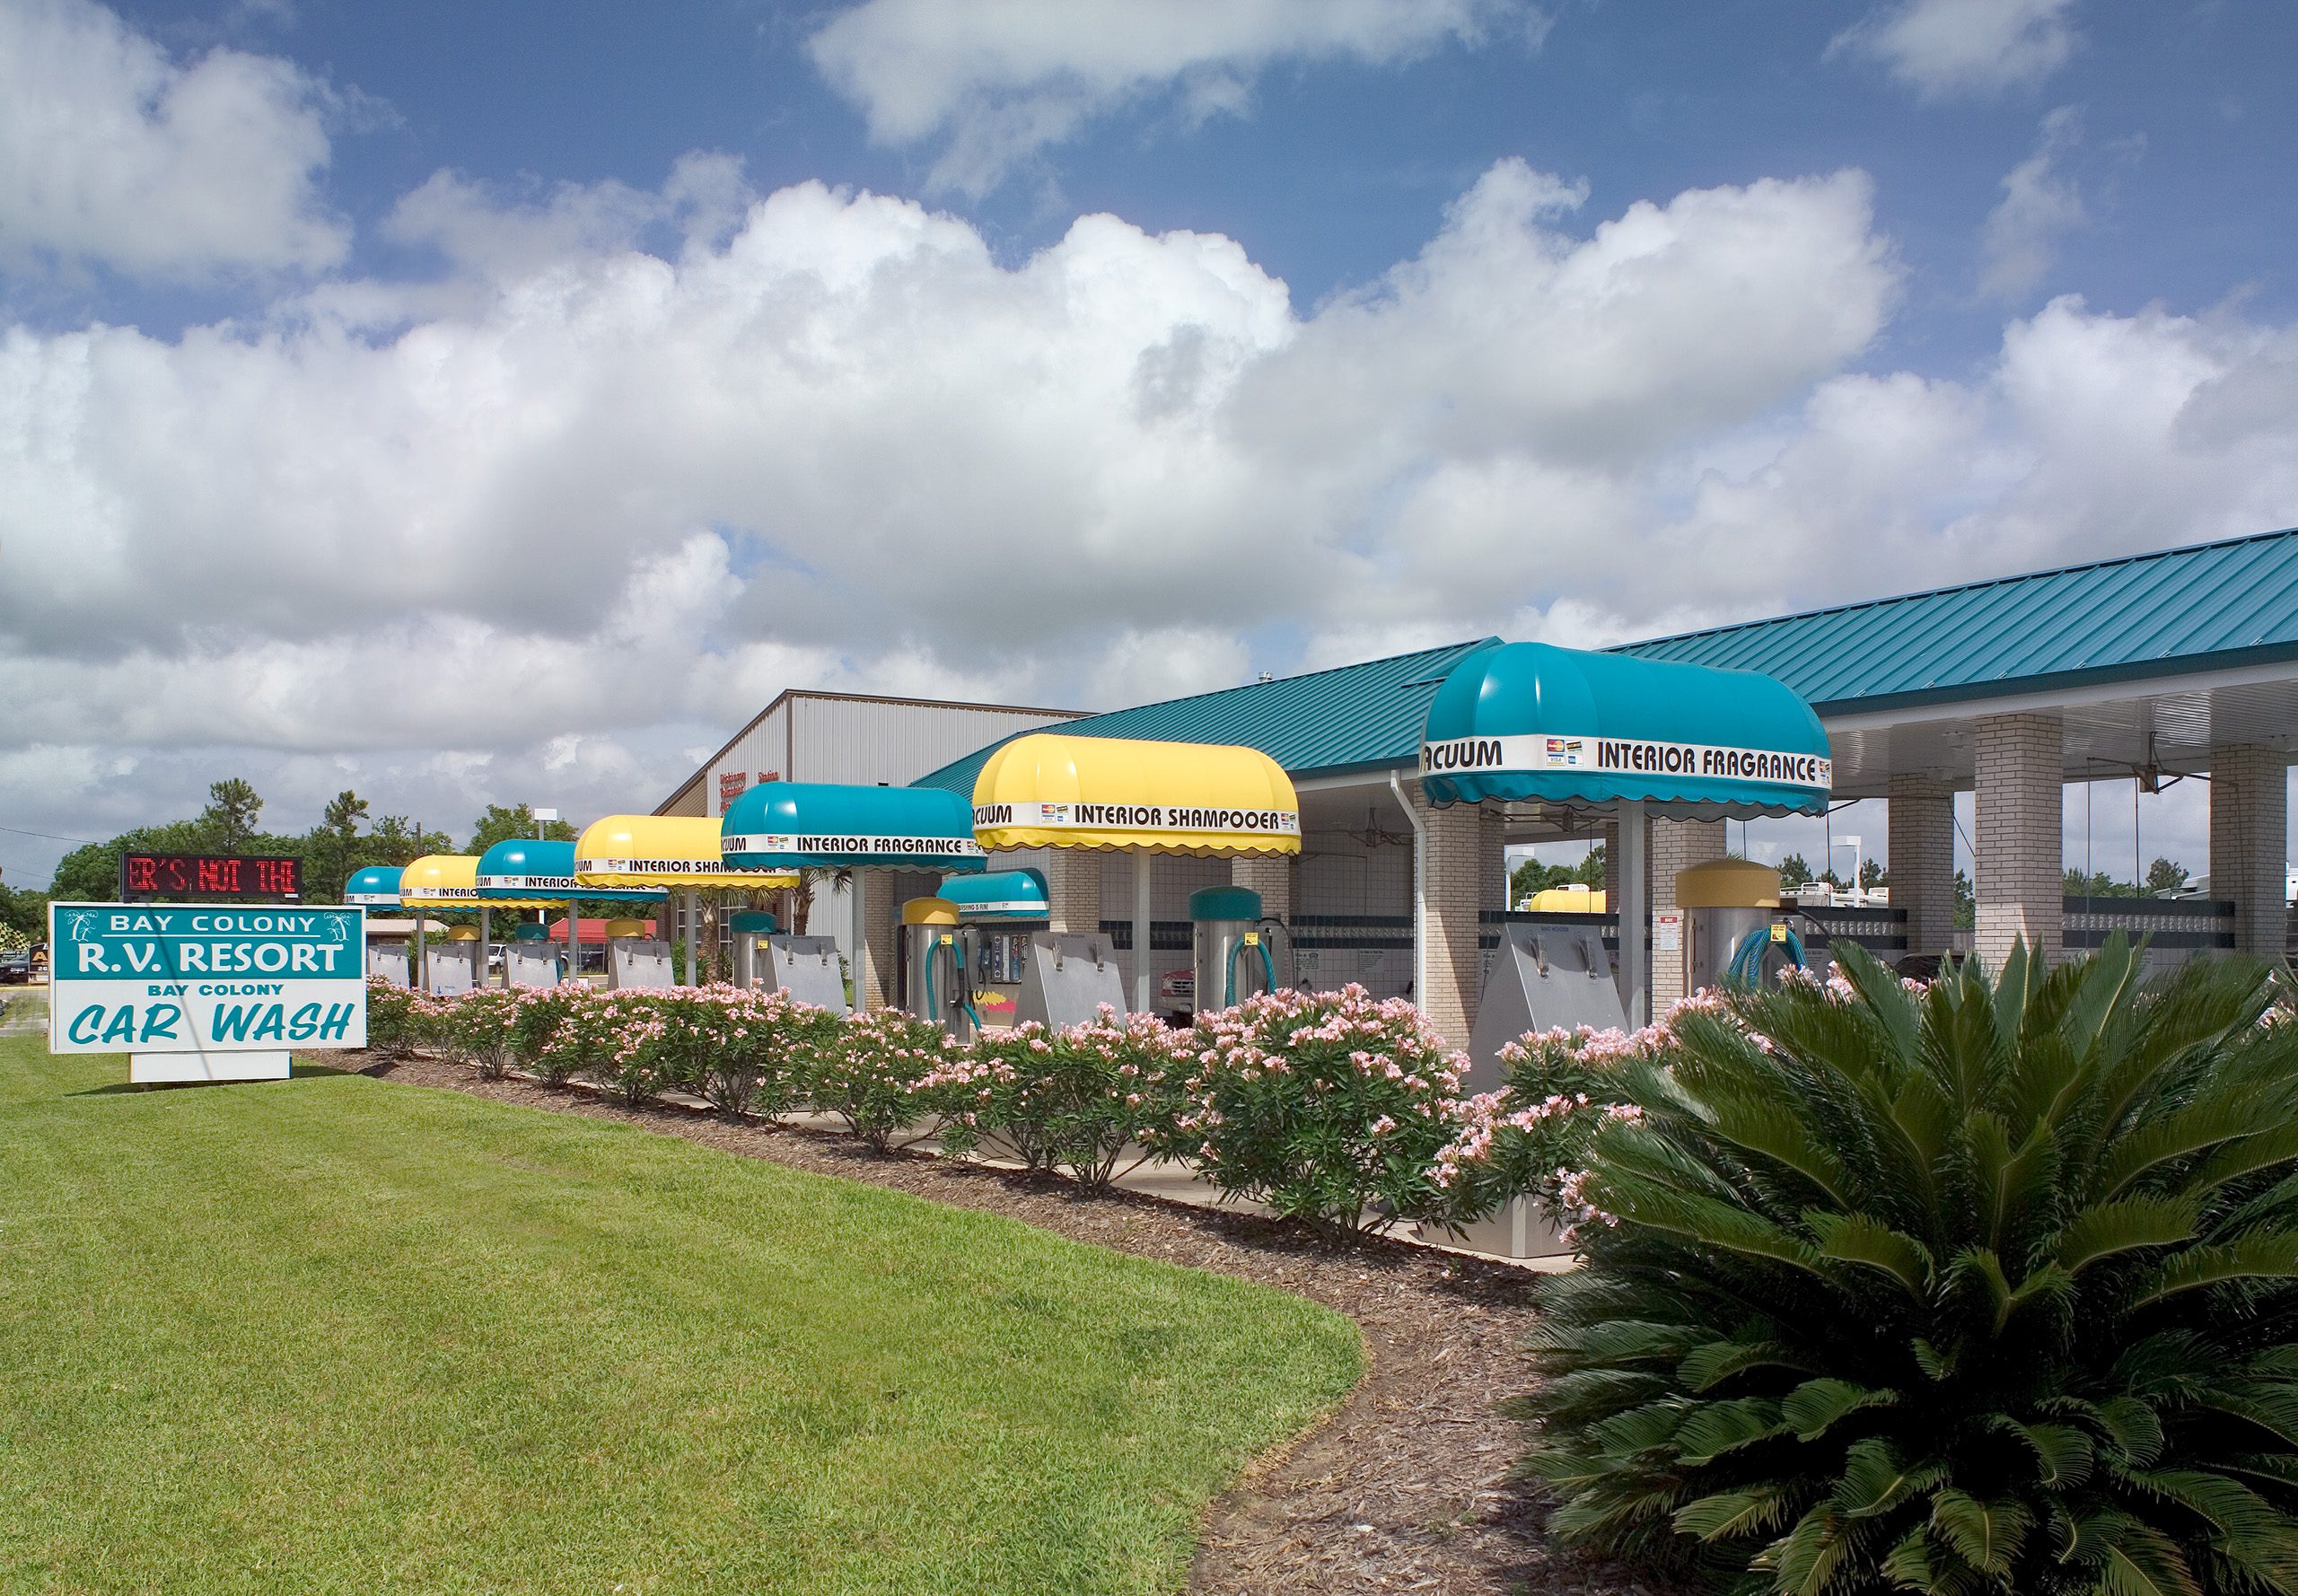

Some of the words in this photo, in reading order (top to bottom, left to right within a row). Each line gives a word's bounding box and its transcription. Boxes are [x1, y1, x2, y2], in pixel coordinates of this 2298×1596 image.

[1421, 741, 1503, 773] ACUUM
[1598, 741, 1695, 773] INTERIOR
[1703, 749, 1815, 782] FRAGRANCE
[1075, 805, 1162, 826] INTERIOR
[1168, 809, 1280, 829] SHAMPOOER
[797, 837, 869, 852] INTERIOR
[874, 839, 961, 853] FRAGRANCE
[198, 859, 241, 891] NOT
[256, 861, 295, 892] THE
[629, 860, 691, 873] INTERIOR
[439, 888, 478, 897] INTERIO
[110, 915, 173, 932] BAY
[192, 916, 316, 933] COLONY
[78, 943, 162, 973] R.V.
[179, 943, 344, 972] RESORT
[147, 984, 189, 996] BAY
[198, 984, 285, 996] COLONY
[68, 1003, 181, 1045] CAR
[211, 1002, 355, 1042] WASH
